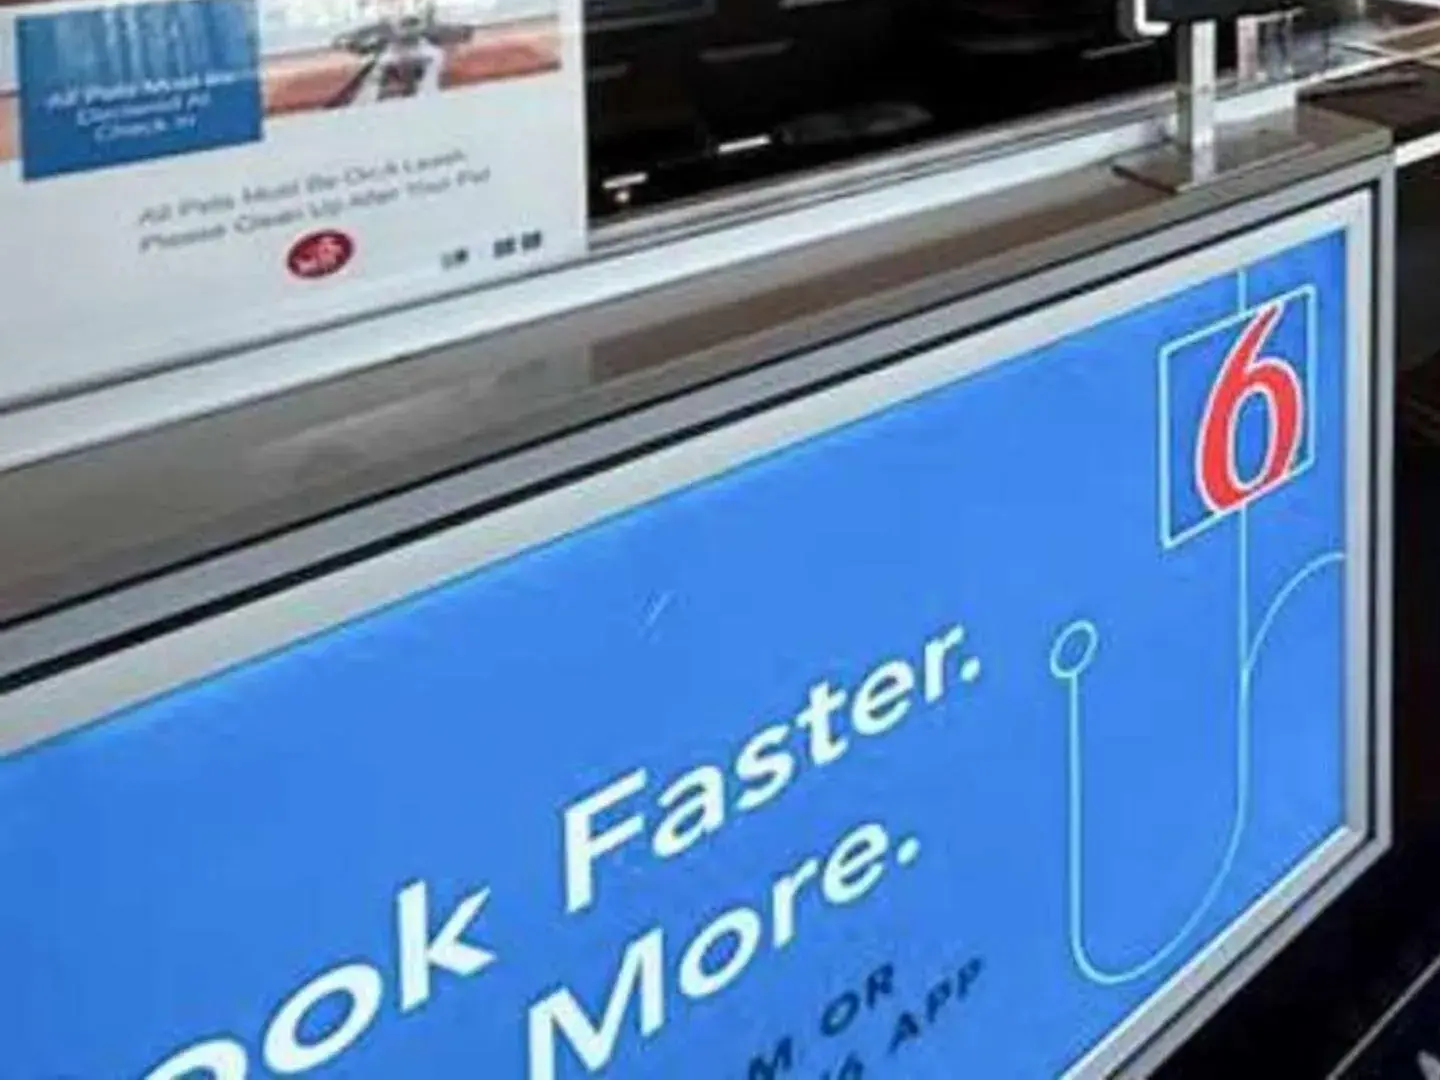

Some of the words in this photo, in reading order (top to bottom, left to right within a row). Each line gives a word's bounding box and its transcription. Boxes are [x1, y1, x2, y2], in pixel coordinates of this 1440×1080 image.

[1195, 298, 1304, 513] 6
[563, 624, 982, 914] Faster.
[527, 822, 922, 1080] More.
[819, 961, 895, 1037] OR
[886, 956, 983, 1056] APP
